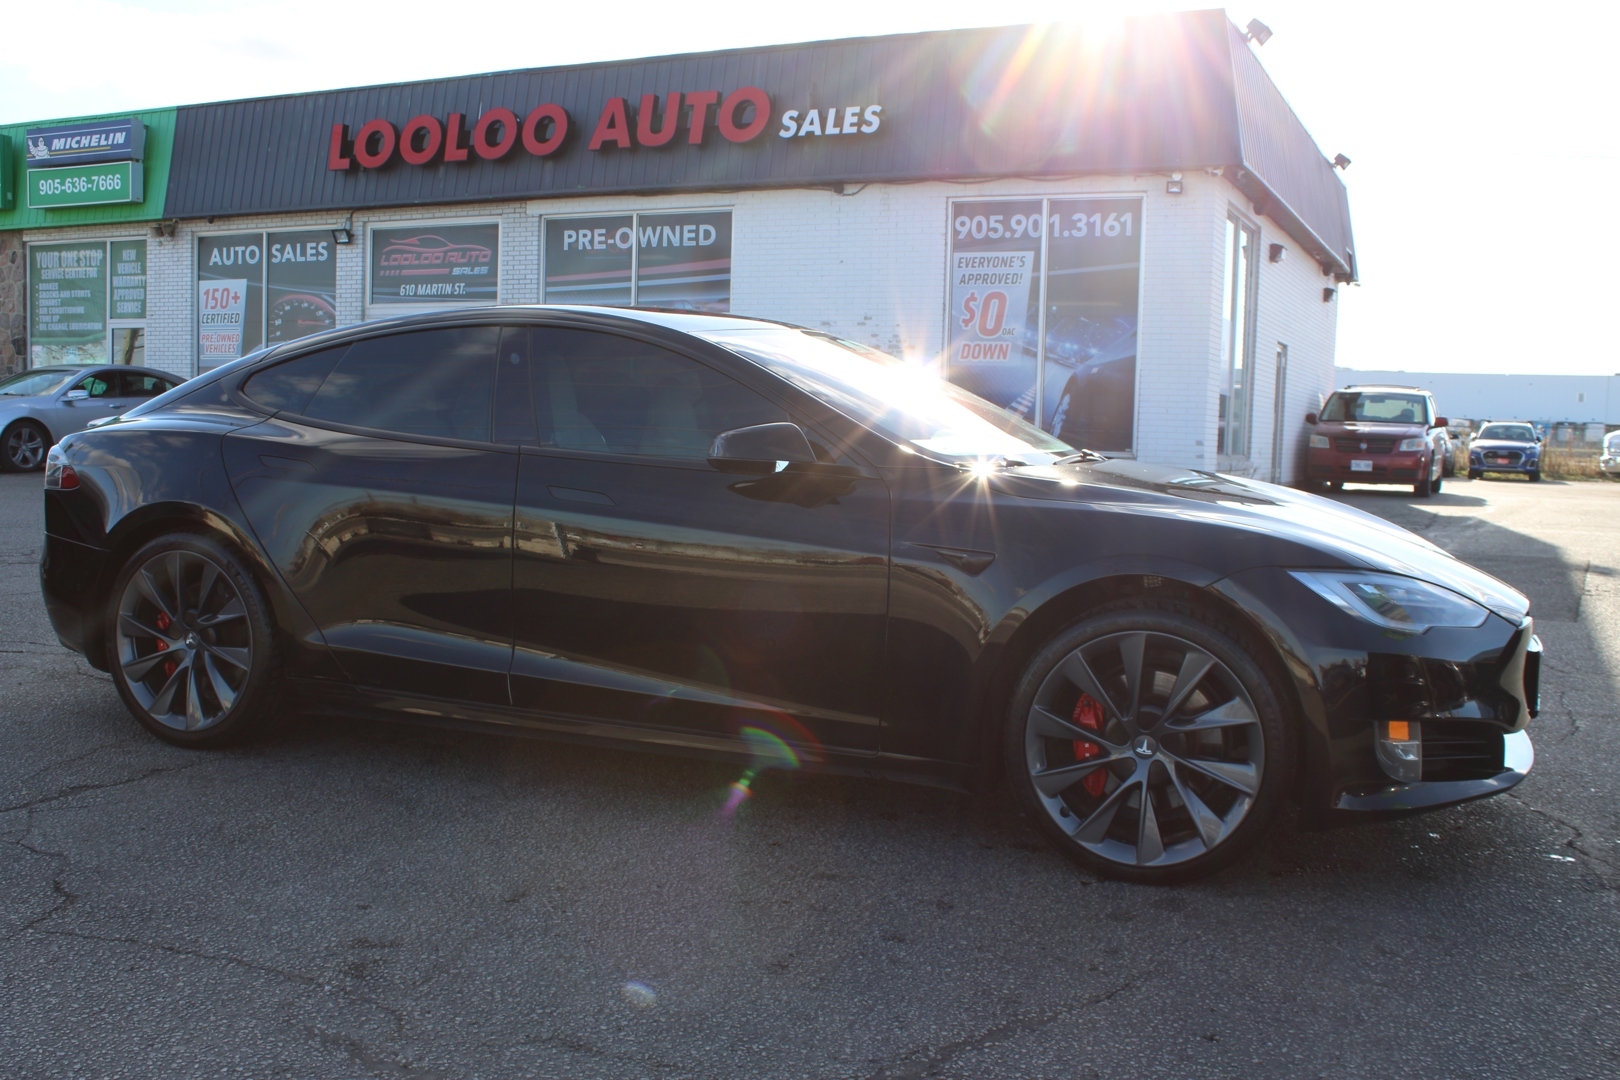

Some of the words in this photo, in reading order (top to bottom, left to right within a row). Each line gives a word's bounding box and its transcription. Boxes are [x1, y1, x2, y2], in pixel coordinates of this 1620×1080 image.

[328, 102, 568, 171] LOOLOO
[587, 86, 771, 151] AUTO
[778, 105, 882, 138] SALES
[51, 132, 127, 151] MICHELIN
[39, 174, 121, 195] 905-636-7666
[954, 212, 1133, 239] 905.901.3161
[563, 224, 717, 251] PRE-OWNED
[36, 251, 60, 269] YOUR
[61, 250, 78, 268] ONE
[79, 249, 103, 267] STOP
[209, 245, 260, 266] AUTO
[271, 241, 328, 264] SALES
[380, 252, 444, 266] LOOLOO
[445, 250, 492, 263] AUTO
[957, 255, 1026, 269] EVERYONE'S
[451, 266, 490, 275] SALES
[958, 273, 1023, 285] APPROVED!
[400, 284, 415, 296] 610
[417, 283, 452, 296] MARTIN
[454, 282, 466, 295] ST.
[203, 287, 241, 310] 150+
[201, 312, 240, 324] CERTIFIED
[961, 291, 1008, 337] $0
[1002, 327, 1016, 336] OAC
[201, 333, 240, 344] PRE-OWNED
[205, 343, 236, 353] VEHICLES
[960, 343, 1010, 360] DOWN
